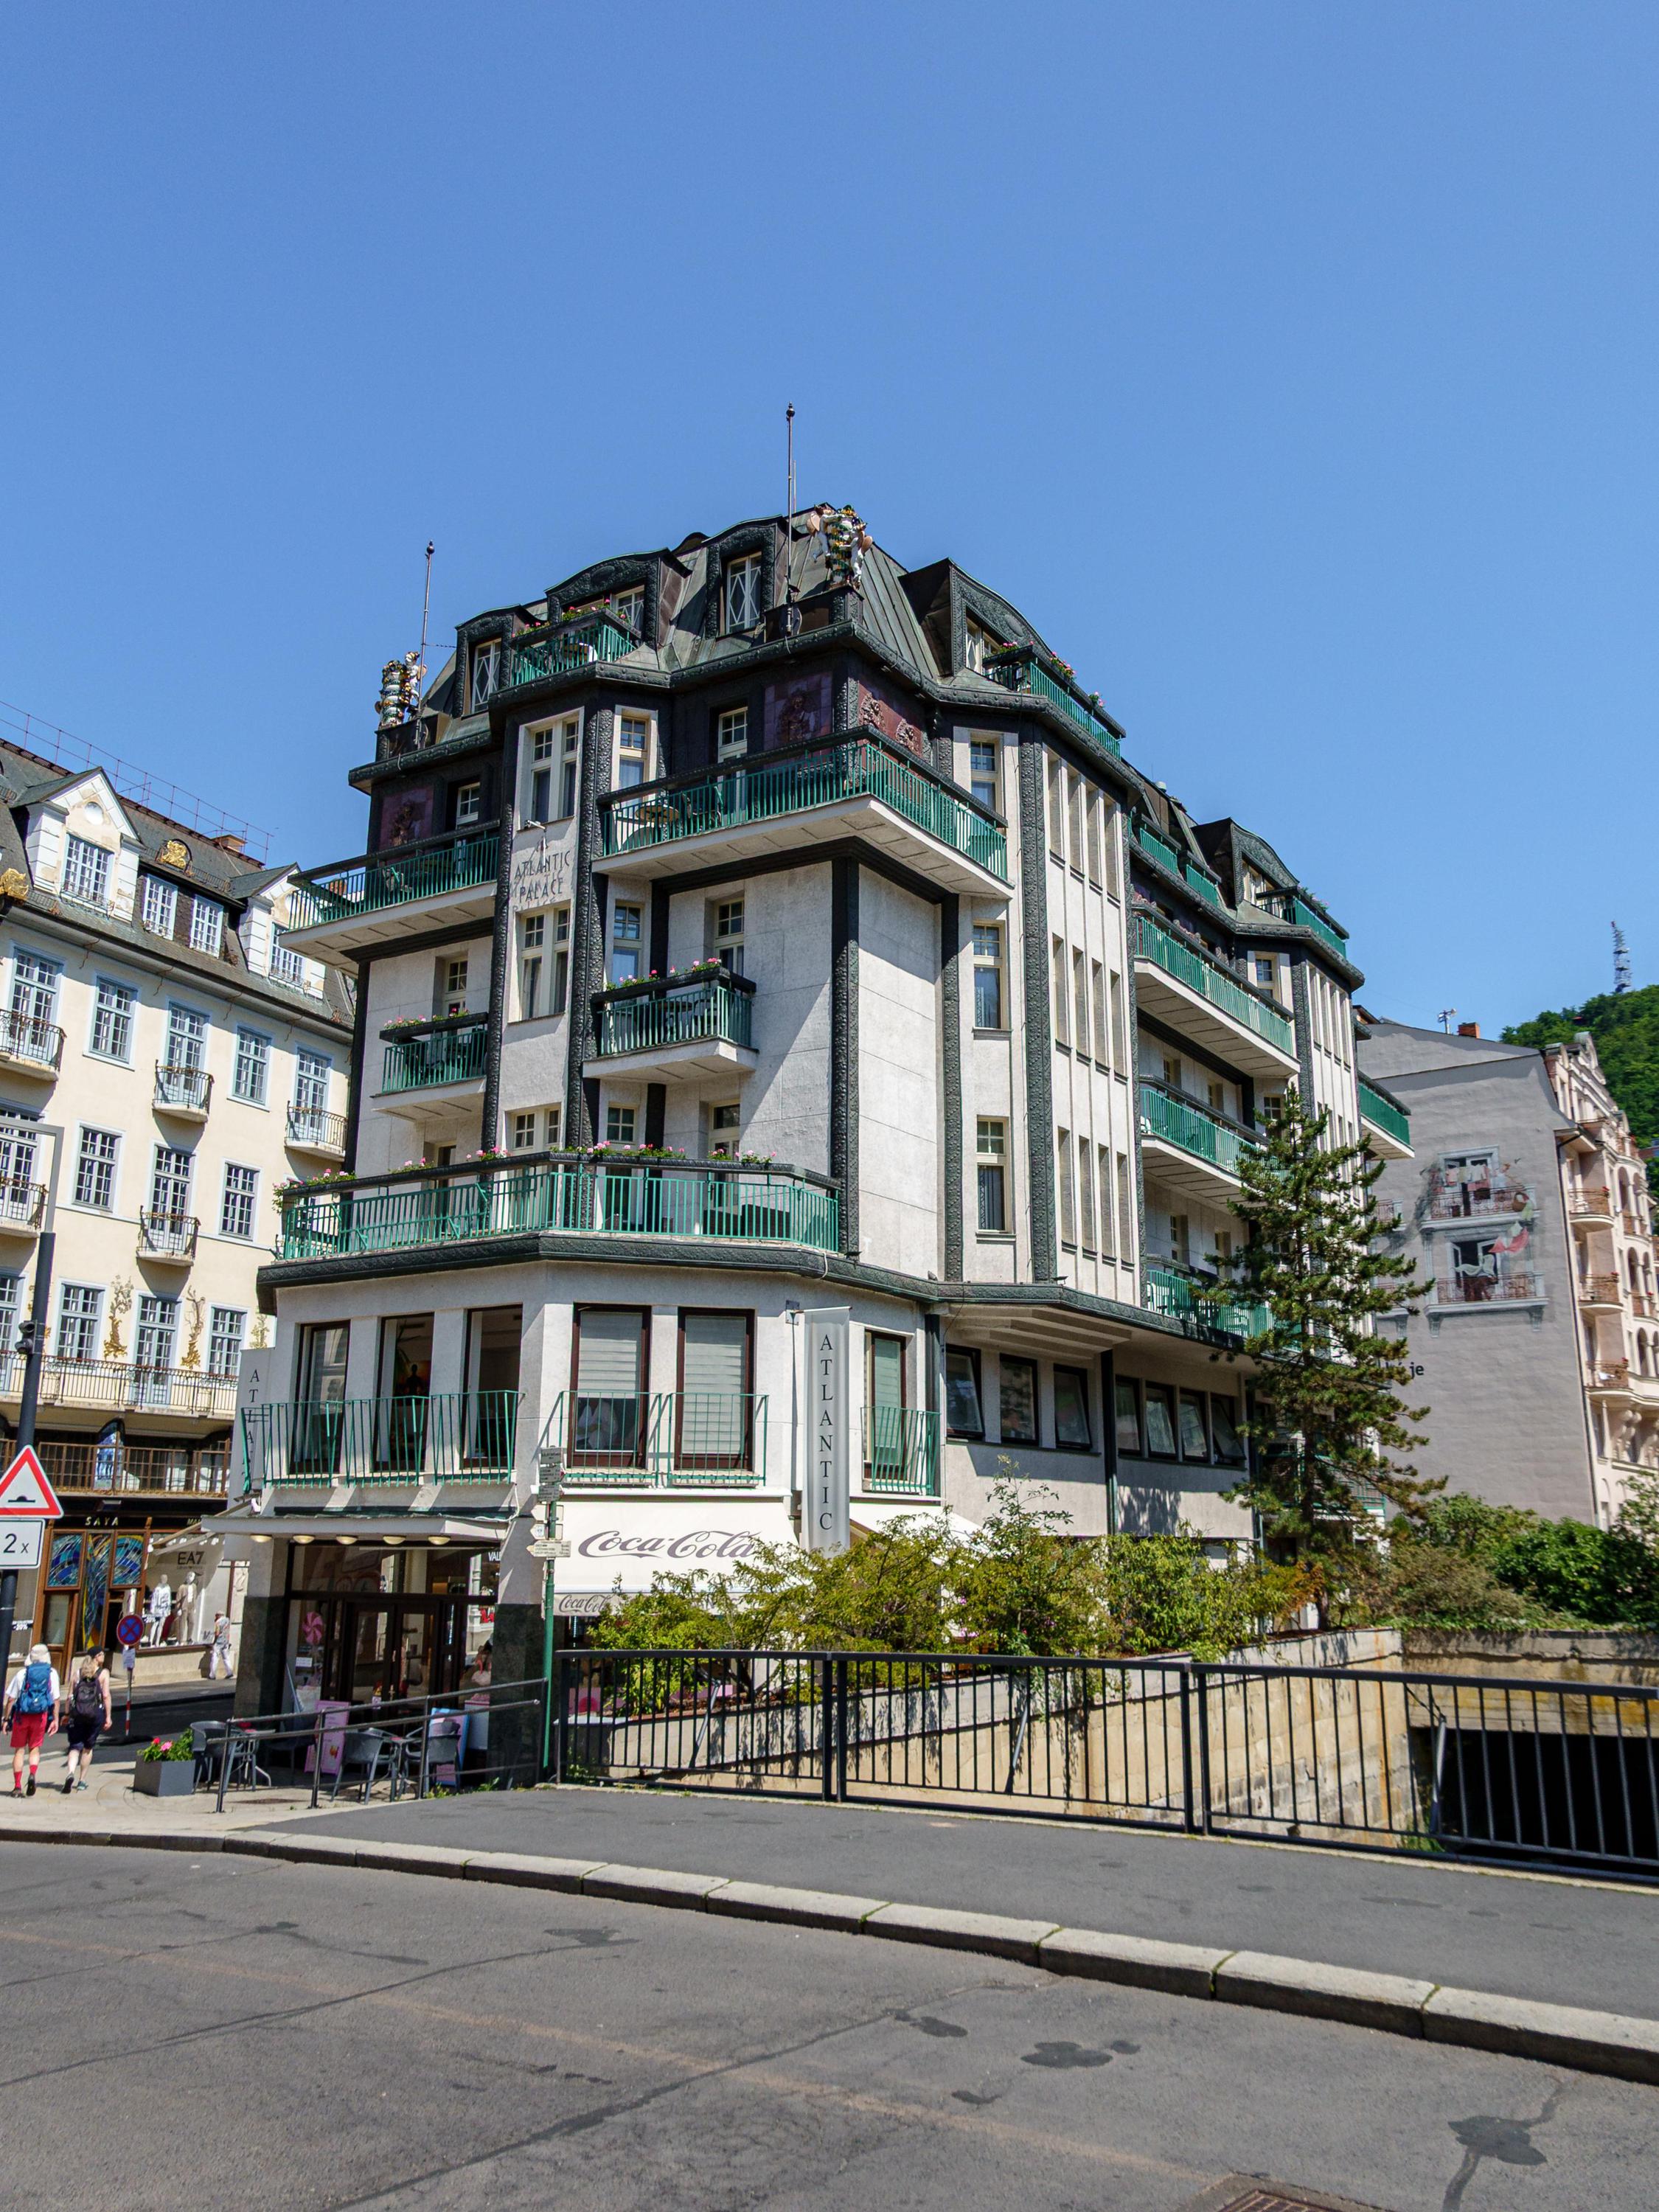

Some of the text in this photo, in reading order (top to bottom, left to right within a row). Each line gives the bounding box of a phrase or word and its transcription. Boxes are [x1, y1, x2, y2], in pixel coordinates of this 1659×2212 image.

[514, 850, 571, 880] ATLANTIC
[519, 877, 564, 904] PALACE
[819, 1334, 833, 1531] ATLANTIC
[85, 1516, 118, 1526] SAYA
[3, 1533, 18, 1554] 2
[578, 1530, 762, 1559] Coca-Cola
[178, 1551, 204, 1565] EA7
[559, 1594, 616, 1613] Coca-Col
